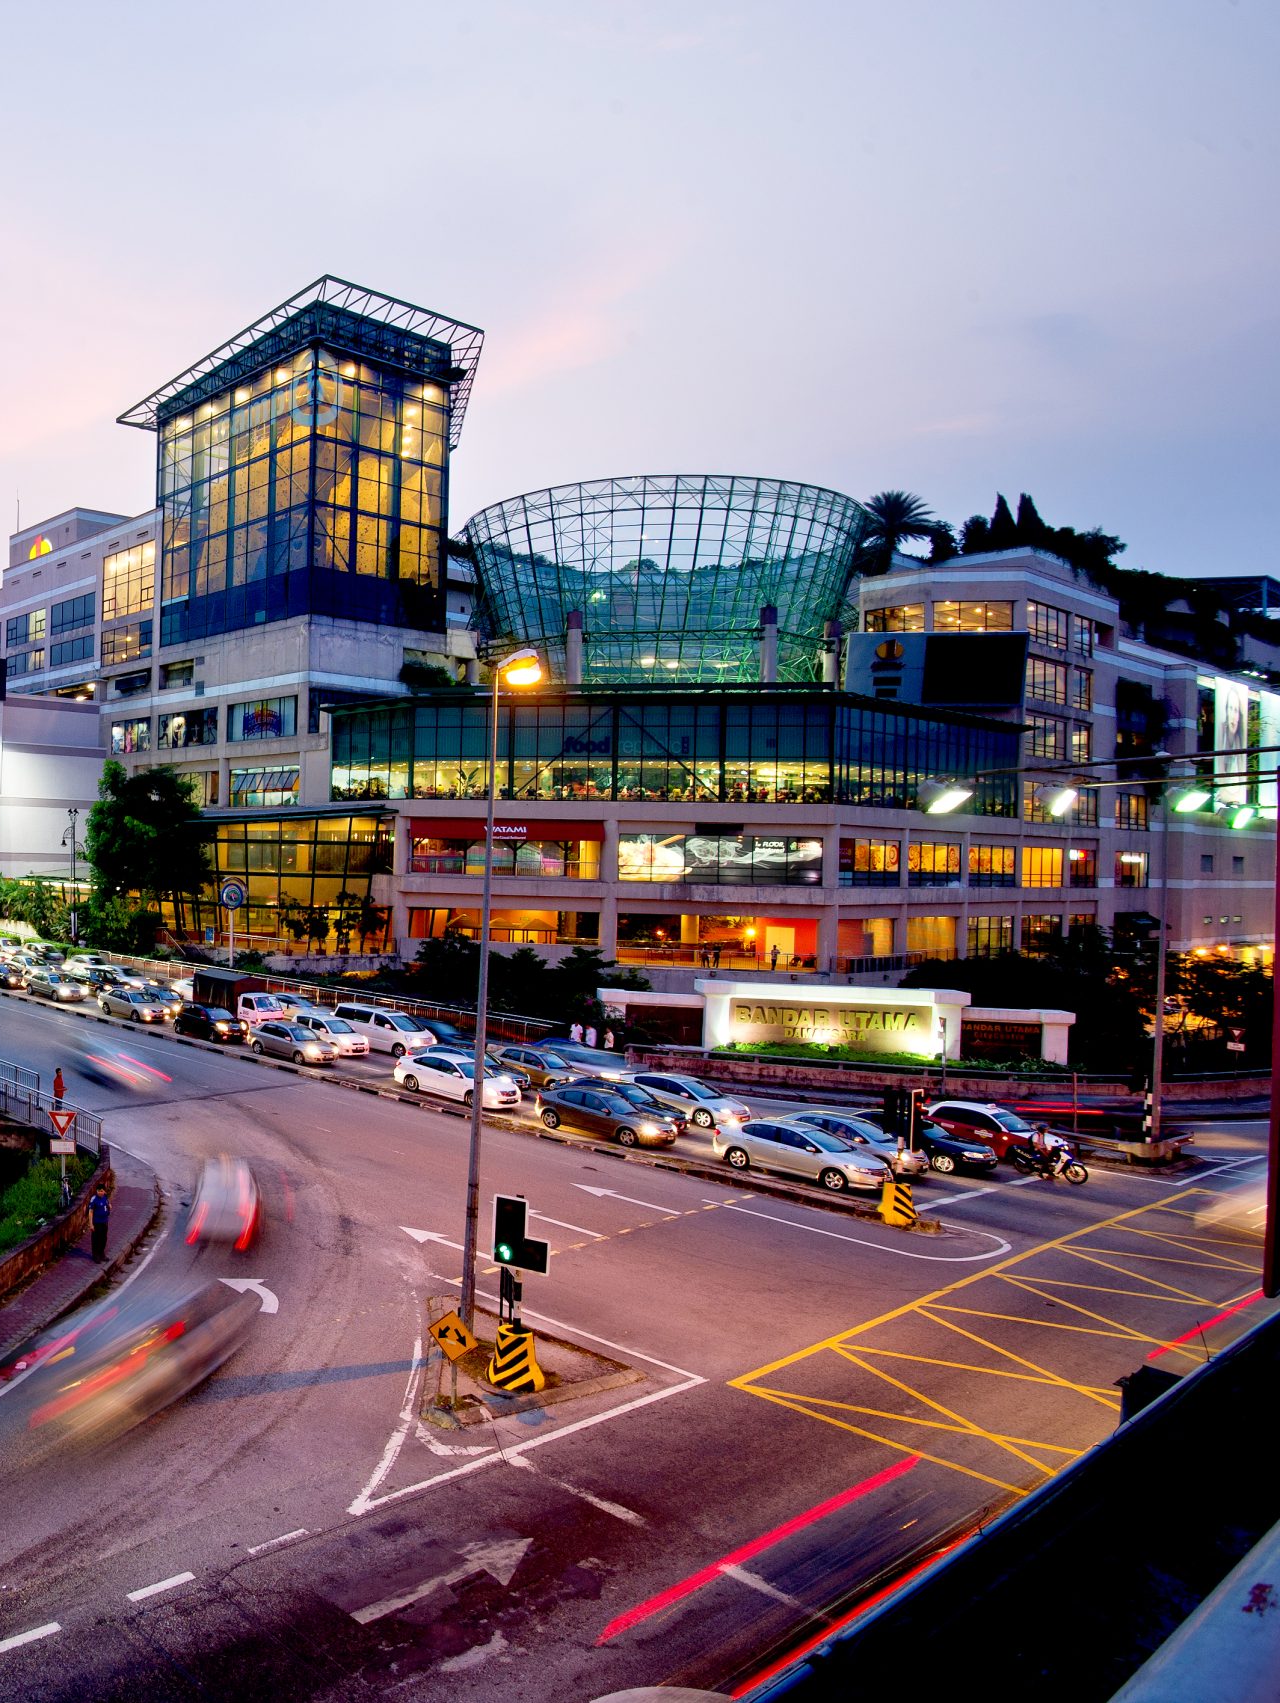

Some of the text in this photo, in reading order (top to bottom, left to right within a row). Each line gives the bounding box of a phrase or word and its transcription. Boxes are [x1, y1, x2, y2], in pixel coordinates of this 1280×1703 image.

[563, 735, 611, 754] food
[735, 1005, 922, 1032] BANDAR UTAMA
[1005, 1025, 1040, 1034] UTAMA
